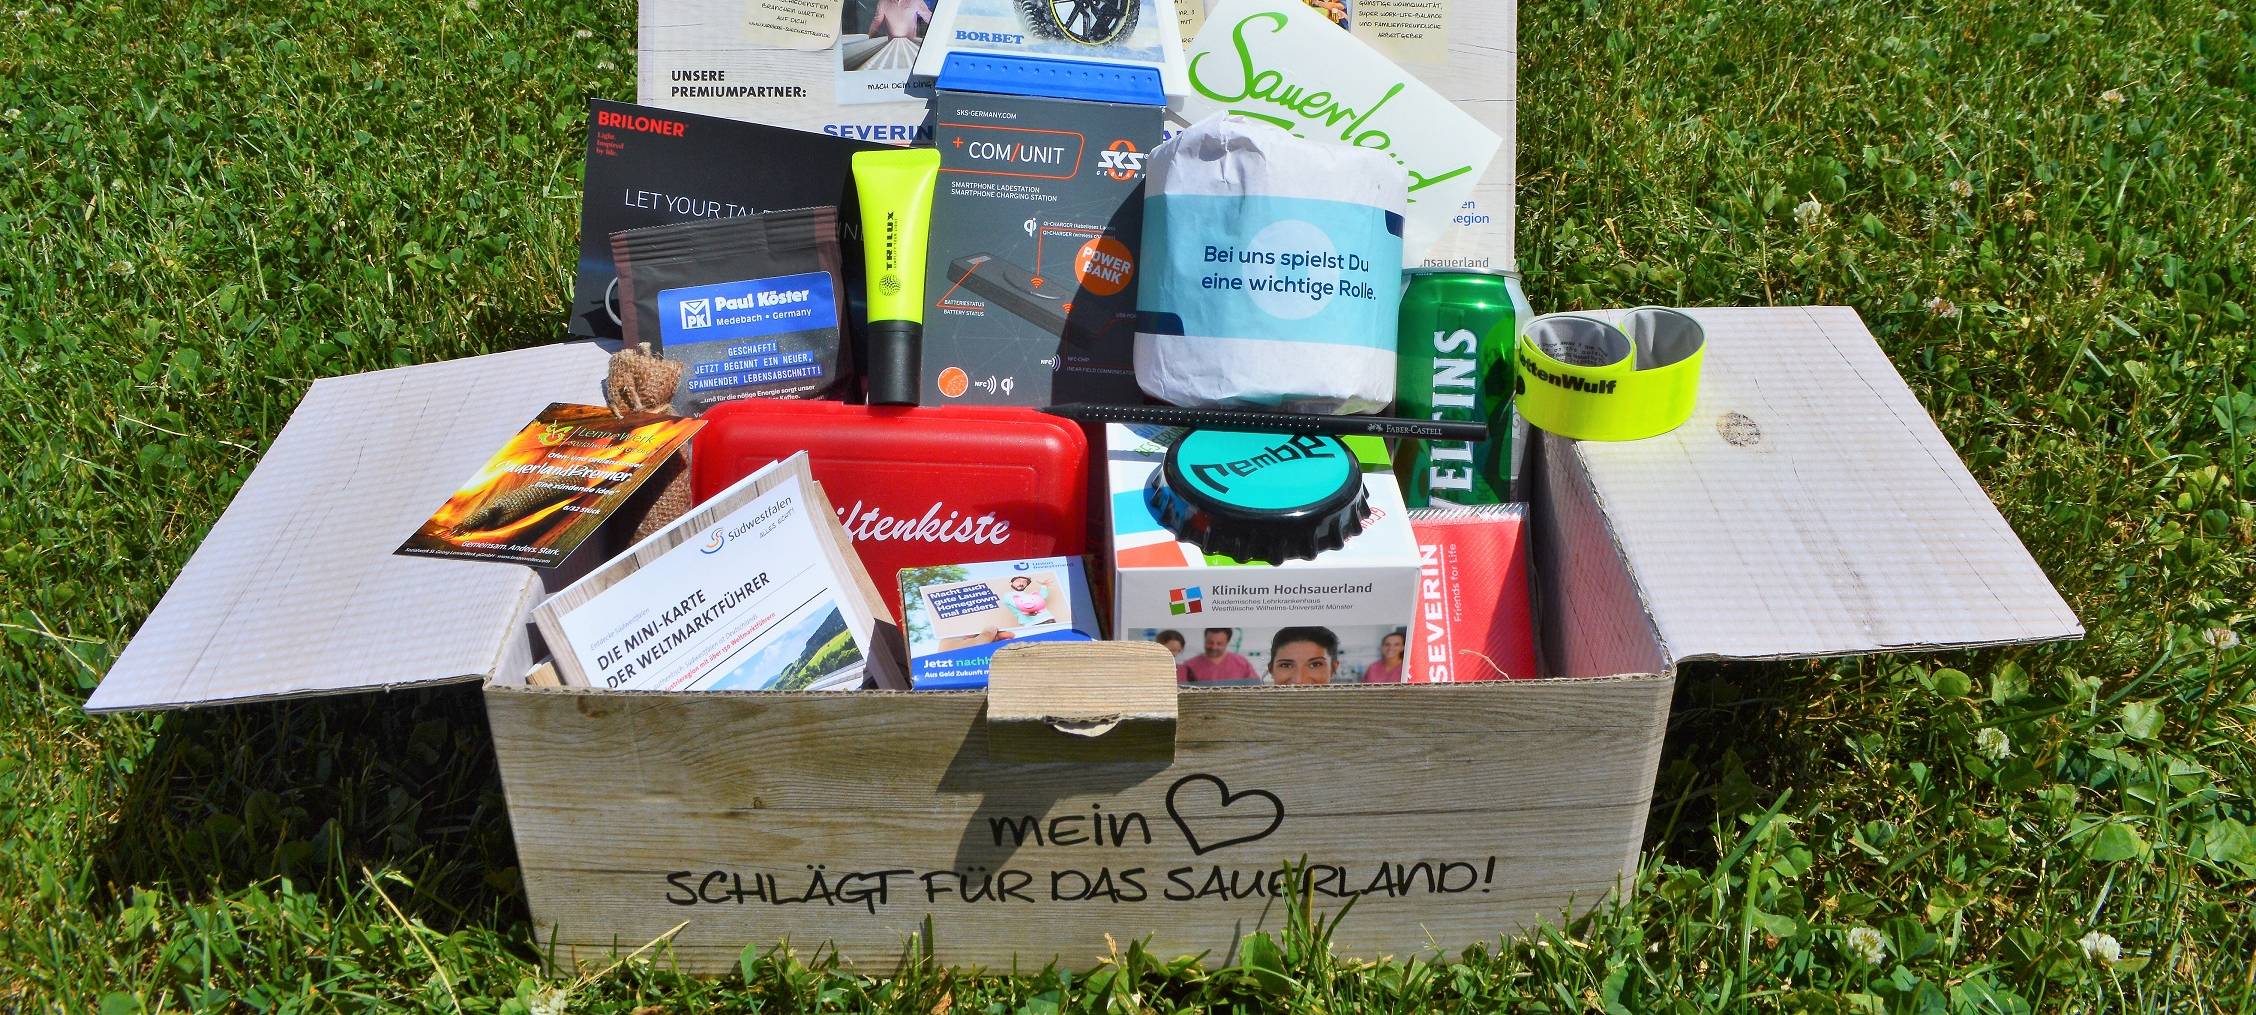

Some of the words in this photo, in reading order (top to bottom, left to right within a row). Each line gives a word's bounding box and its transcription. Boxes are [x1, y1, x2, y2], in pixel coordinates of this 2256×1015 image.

[954, 30, 1025, 45] BORBET
[670, 69, 726, 83] UNSERE
[670, 85, 808, 98] PREMIUMPARTNER:
[598, 111, 685, 137] BRILONER
[823, 124, 934, 140] SEVERIN
[1098, 150, 1142, 170] SKS
[951, 182, 996, 191] SMARTPHONE
[996, 184, 1040, 193] LADESTATION
[951, 189, 996, 198] SMARTPHONE
[996, 191, 1030, 200] CHARGING
[1030, 193, 1058, 202] STATION
[625, 188, 662, 210] LET
[665, 194, 720, 221] YOUR
[886, 211, 895, 271] TRILUX
[1082, 246, 1131, 273] POWER
[1203, 245, 1234, 263] Bei
[1238, 250, 1276, 265] uns
[1280, 250, 1344, 270] spielst
[1348, 254, 1369, 272] Du
[1420, 257, 1489, 267] nsauerland
[1083, 260, 1122, 284] BANK
[1201, 273, 1243, 290] eine
[1249, 275, 1334, 300] wichtige
[1339, 280, 1377, 300] Rolle.
[715, 292, 754, 312] Paul
[757, 289, 810, 307] Köster
[716, 313, 763, 326] Medebach
[772, 308, 812, 321] Germany
[727, 343, 778, 357] GESCHAFFT!
[694, 364, 719, 375] JETZT
[724, 360, 758, 371] BEGINNT
[763, 357, 779, 366] EIN
[783, 354, 813, 364] NEUER,
[688, 373, 739, 390] SPANNENDER
[743, 366, 822, 384] LEBENSABSCHNITT!
[1386, 423, 1442, 435] FABER-CASTELL
[727, 495, 792, 542] Südwestfalen
[461, 540, 507, 551] Gemeinsam.
[508, 544, 537, 554] Anders.
[537, 547, 560, 556] Stark.
[1449, 543, 1458, 564] Life
[1451, 565, 1459, 580] for
[930, 588, 961, 599] Macht
[962, 583, 986, 594] auch
[934, 595, 957, 606] gute
[958, 589, 991, 602] Laune:
[1212, 584, 1270, 596] Klinikum
[1274, 582, 1373, 595] Hochsauerland
[936, 594, 998, 612] Homegrown
[940, 609, 959, 618] mal
[961, 603, 997, 616] anders.
[1451, 581, 1463, 623] Friends
[1419, 544, 1448, 683] SEVERIN
[597, 646, 623, 671] DIE
[624, 589, 706, 653] MINI-KARTE
[606, 665, 637, 689] DER
[636, 572, 770, 669] WELTMARKTFÜHRER
[924, 659, 954, 669] Jetzt
[939, 670, 955, 678] Geld
[956, 669, 983, 677] Zukunft
[665, 863, 914, 916] SCHLÄGT
[920, 865, 1037, 904] FÜR
[1050, 866, 1148, 903] DAS
[1163, 854, 1497, 904] SAUERLAND!
